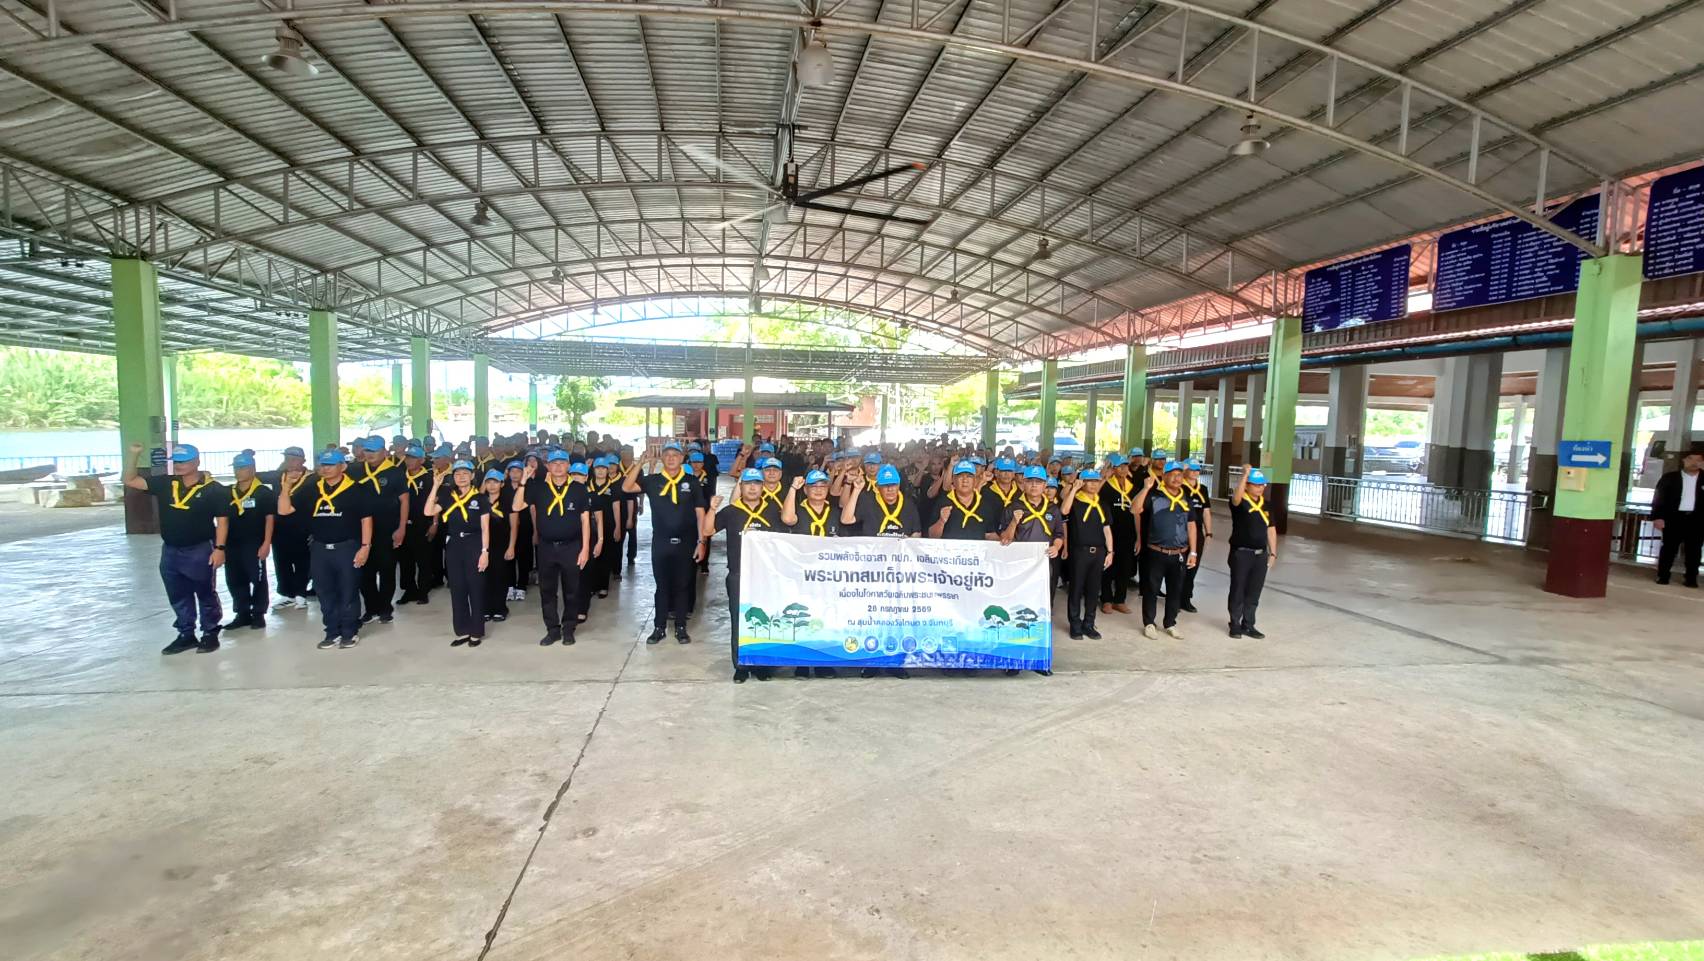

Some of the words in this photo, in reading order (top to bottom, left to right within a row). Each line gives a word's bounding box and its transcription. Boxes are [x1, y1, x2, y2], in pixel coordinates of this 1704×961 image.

[804, 566, 994, 591] พระบาทสมเด็จพระเจ้าอยู่หัว
